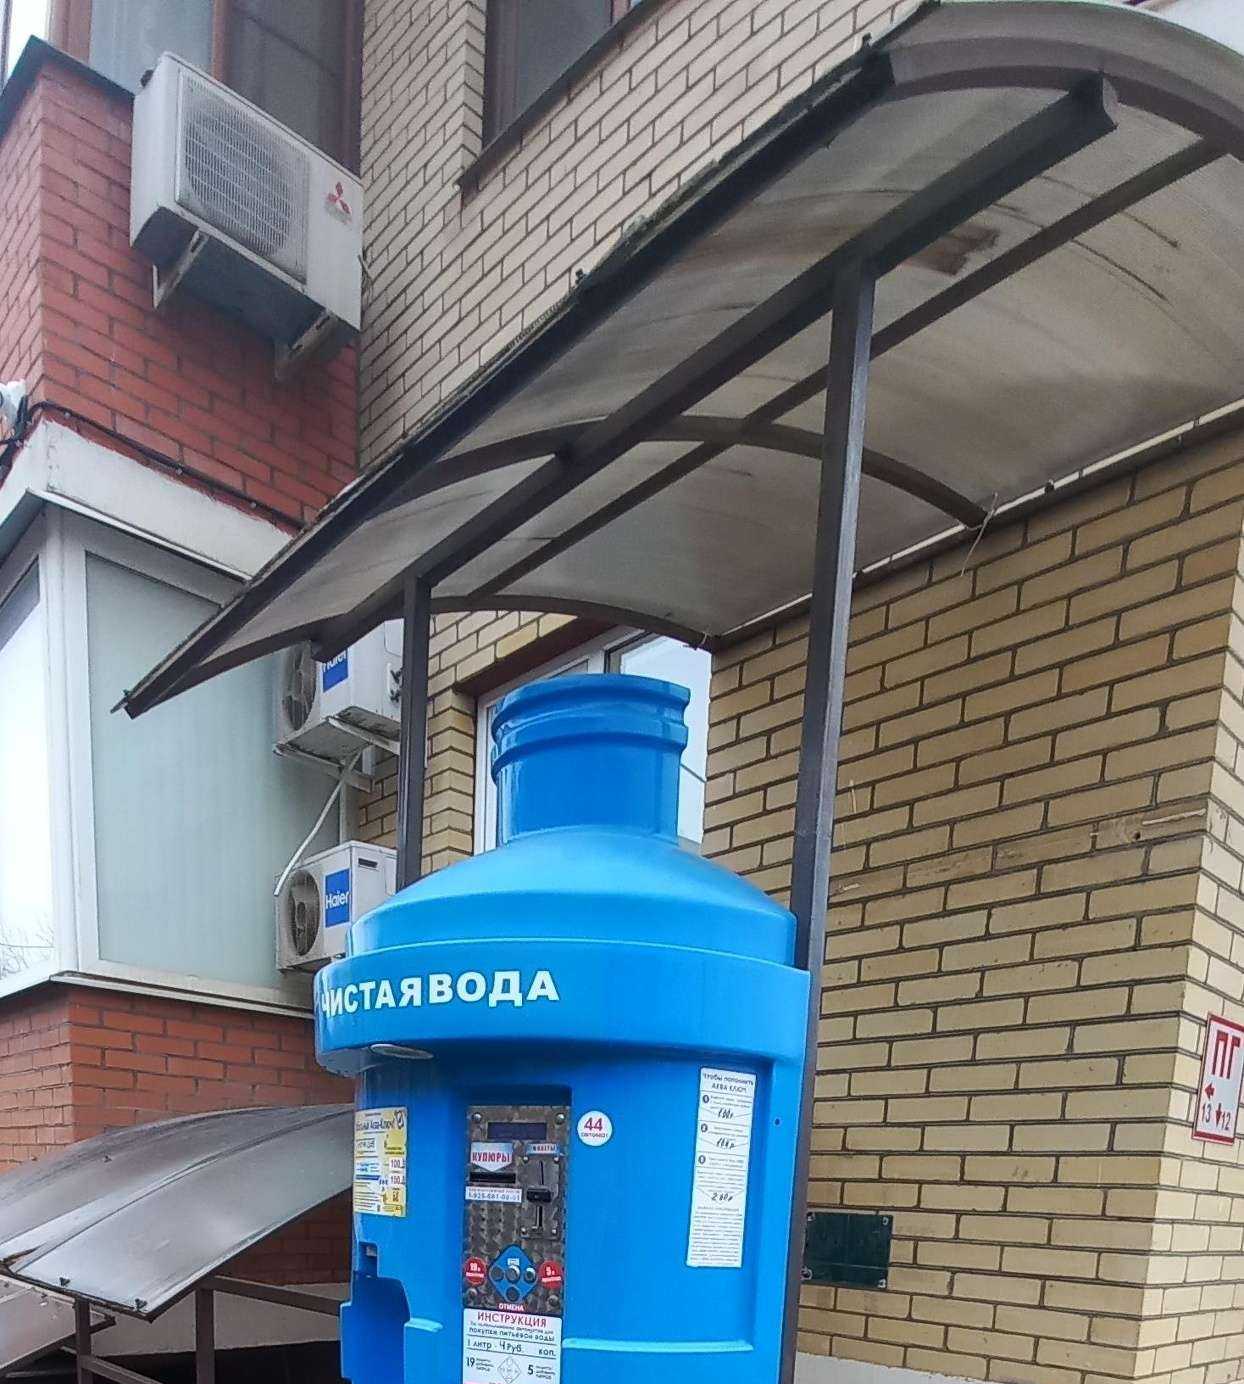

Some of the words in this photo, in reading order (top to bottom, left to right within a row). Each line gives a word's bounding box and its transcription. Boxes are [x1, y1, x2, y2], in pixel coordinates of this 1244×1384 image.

[325, 889, 349, 910] Haier
[322, 976, 422, 1018] ЧИСТАЯ
[429, 970, 560, 1007] ВОДА
[1211, 1029, 1241, 1080] ПГ
[584, 1116, 603, 1132] 44
[1202, 1103, 1212, 1124] 13
[1221, 1112, 1231, 1131] 12
[472, 1151, 511, 1163] КУПЮРЫ
[477, 1311, 547, 1328] ИНСТРУКЦИЯ
[466, 1357, 475, 1368] 19
[527, 1364, 534, 1376] 5
